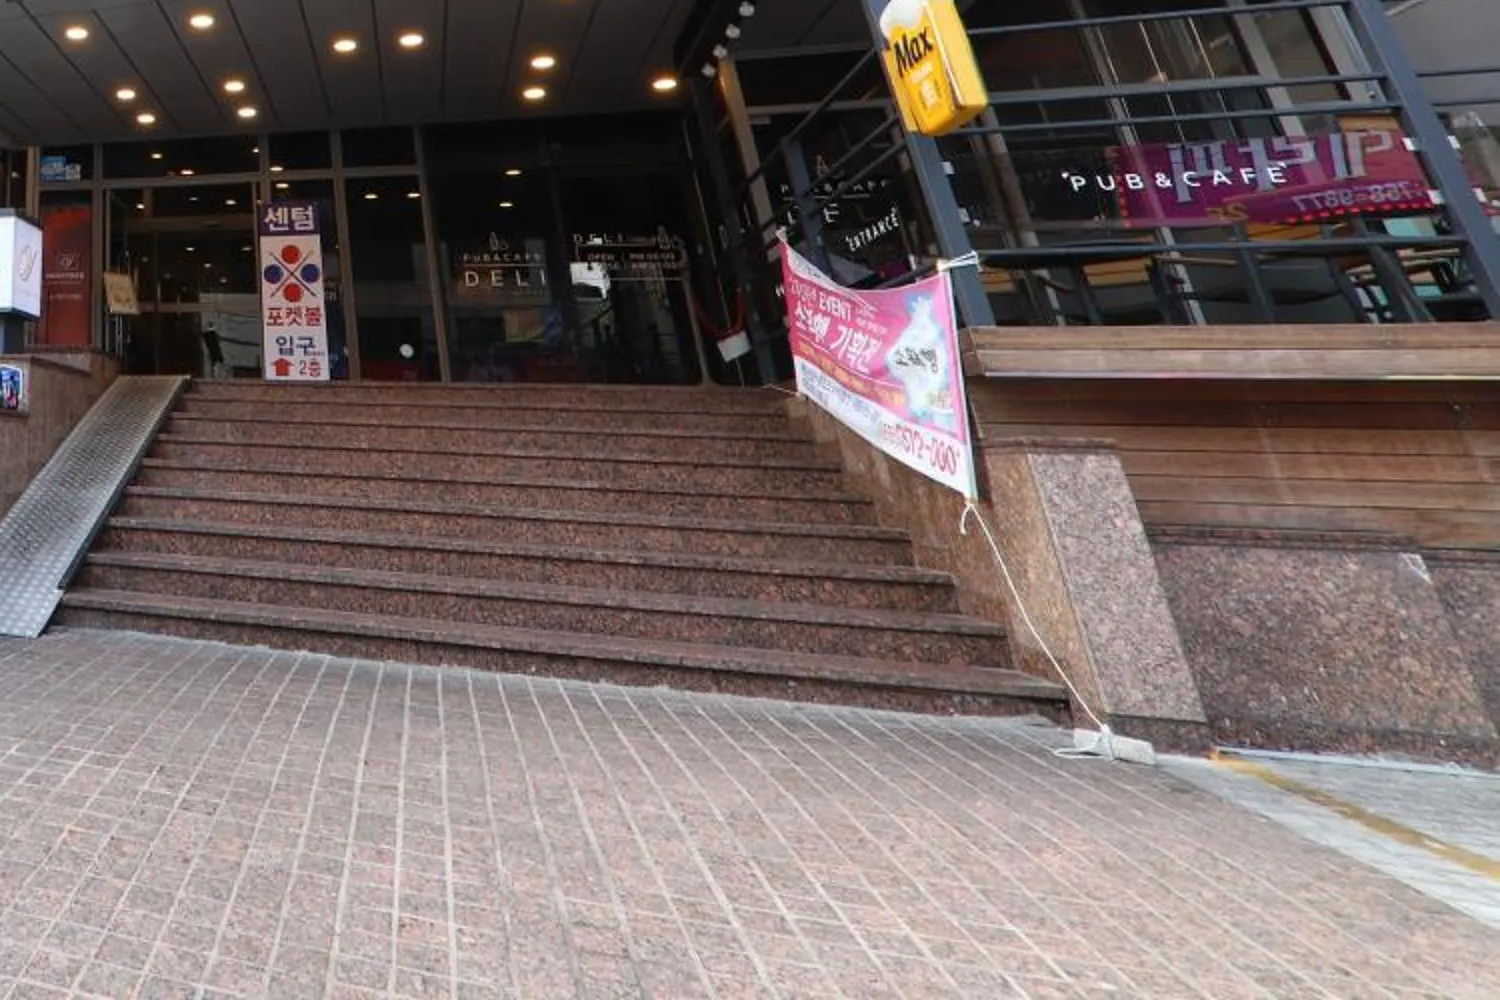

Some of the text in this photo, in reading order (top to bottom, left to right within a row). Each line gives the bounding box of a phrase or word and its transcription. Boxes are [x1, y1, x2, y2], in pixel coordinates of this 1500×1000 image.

[893, 26, 933, 79] Max
[263, 205, 316, 233] 센텀
[464, 269, 547, 288] DELI
[266, 306, 322, 328] 포켓볼
[275, 335, 317, 357] 입구
[298, 358, 322, 378] 2층
